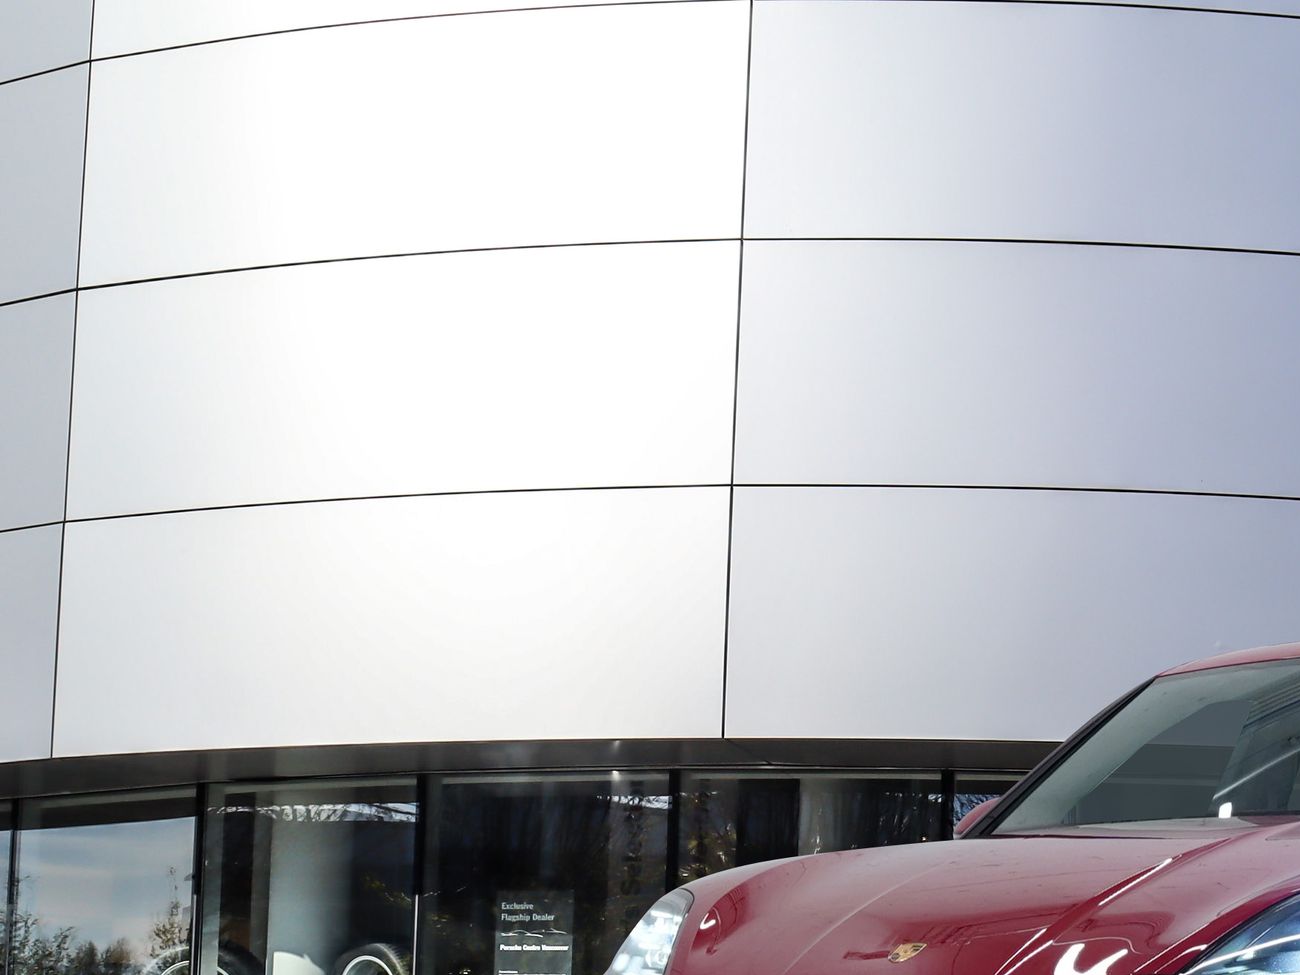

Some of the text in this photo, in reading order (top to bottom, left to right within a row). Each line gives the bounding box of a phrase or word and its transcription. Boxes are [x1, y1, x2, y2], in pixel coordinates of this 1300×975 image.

[501, 902, 534, 910] Exclusive
[501, 913, 555, 922] Flagship Dealer
